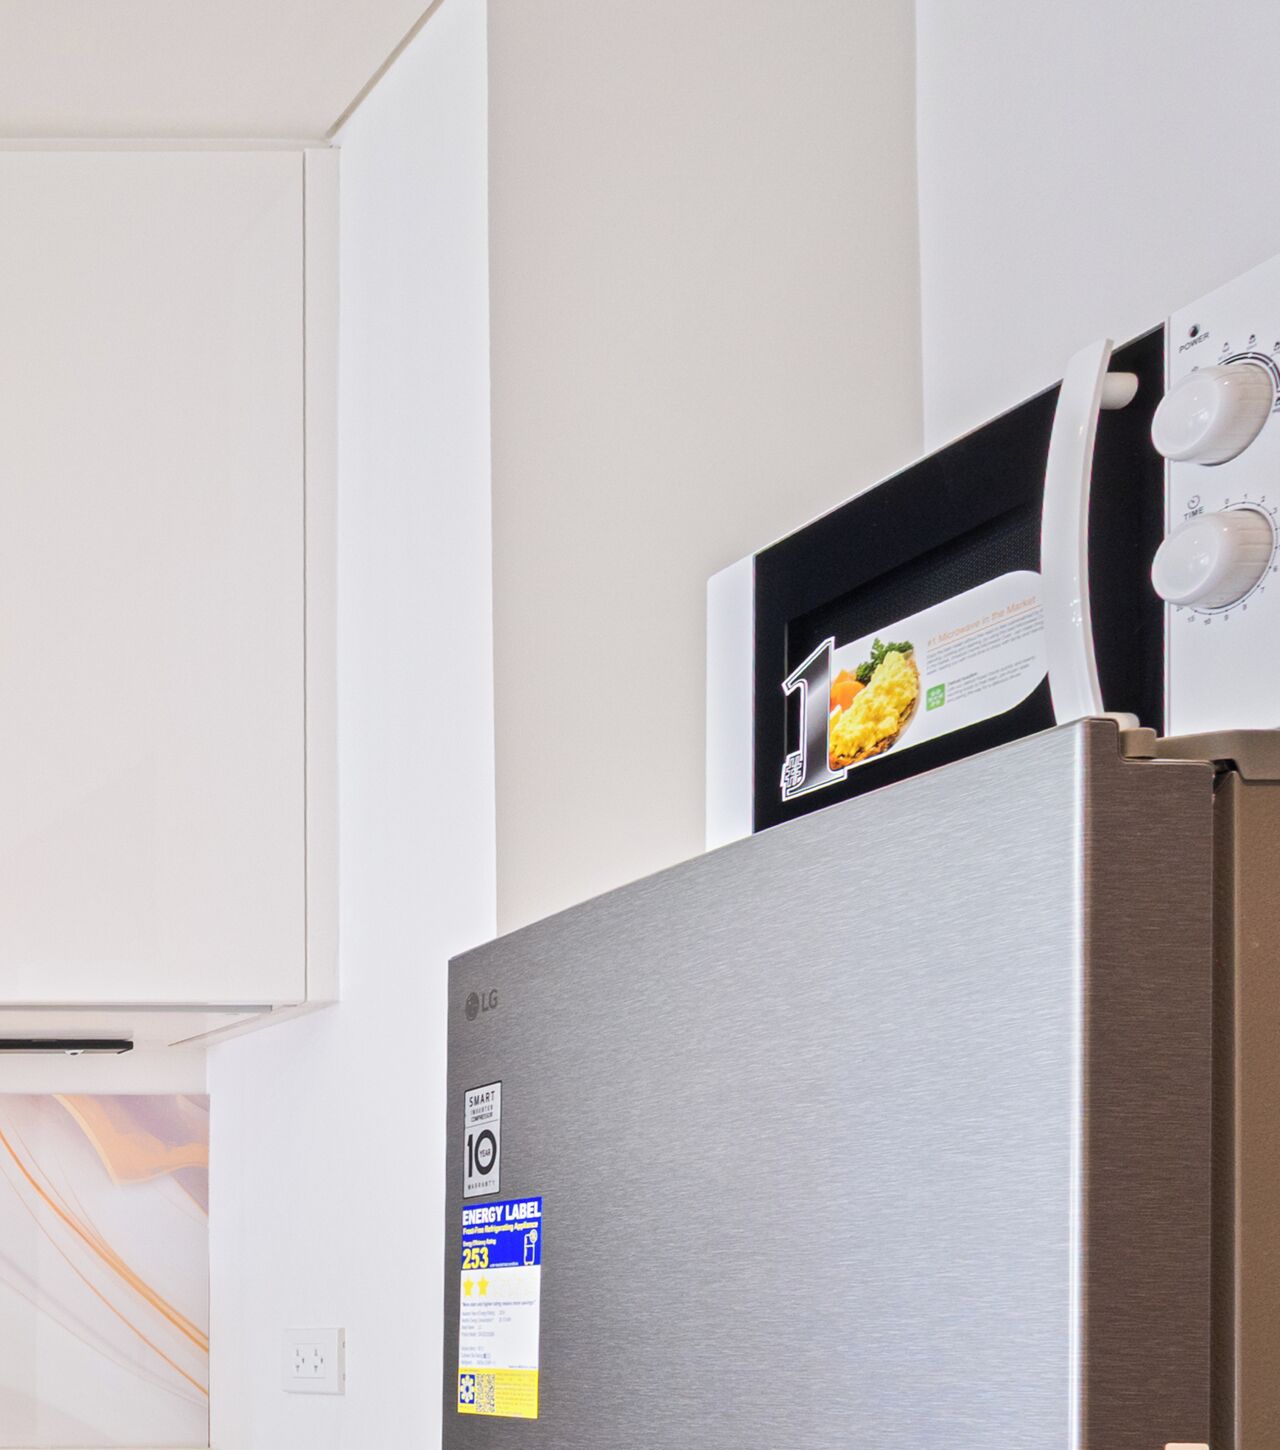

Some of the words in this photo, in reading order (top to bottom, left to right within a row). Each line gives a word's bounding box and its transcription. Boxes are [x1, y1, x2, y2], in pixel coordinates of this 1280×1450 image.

[1179, 332, 1209, 353] POWER
[1184, 506, 1204, 520] TIME
[482, 989, 498, 1012] LG
[469, 1090, 496, 1108] SMART
[467, 1129, 497, 1178] 10
[479, 1148, 491, 1158] YEAR
[462, 1205, 504, 1226] ENERGY
[505, 1200, 542, 1221] LABEL
[462, 1246, 489, 1270] 253
